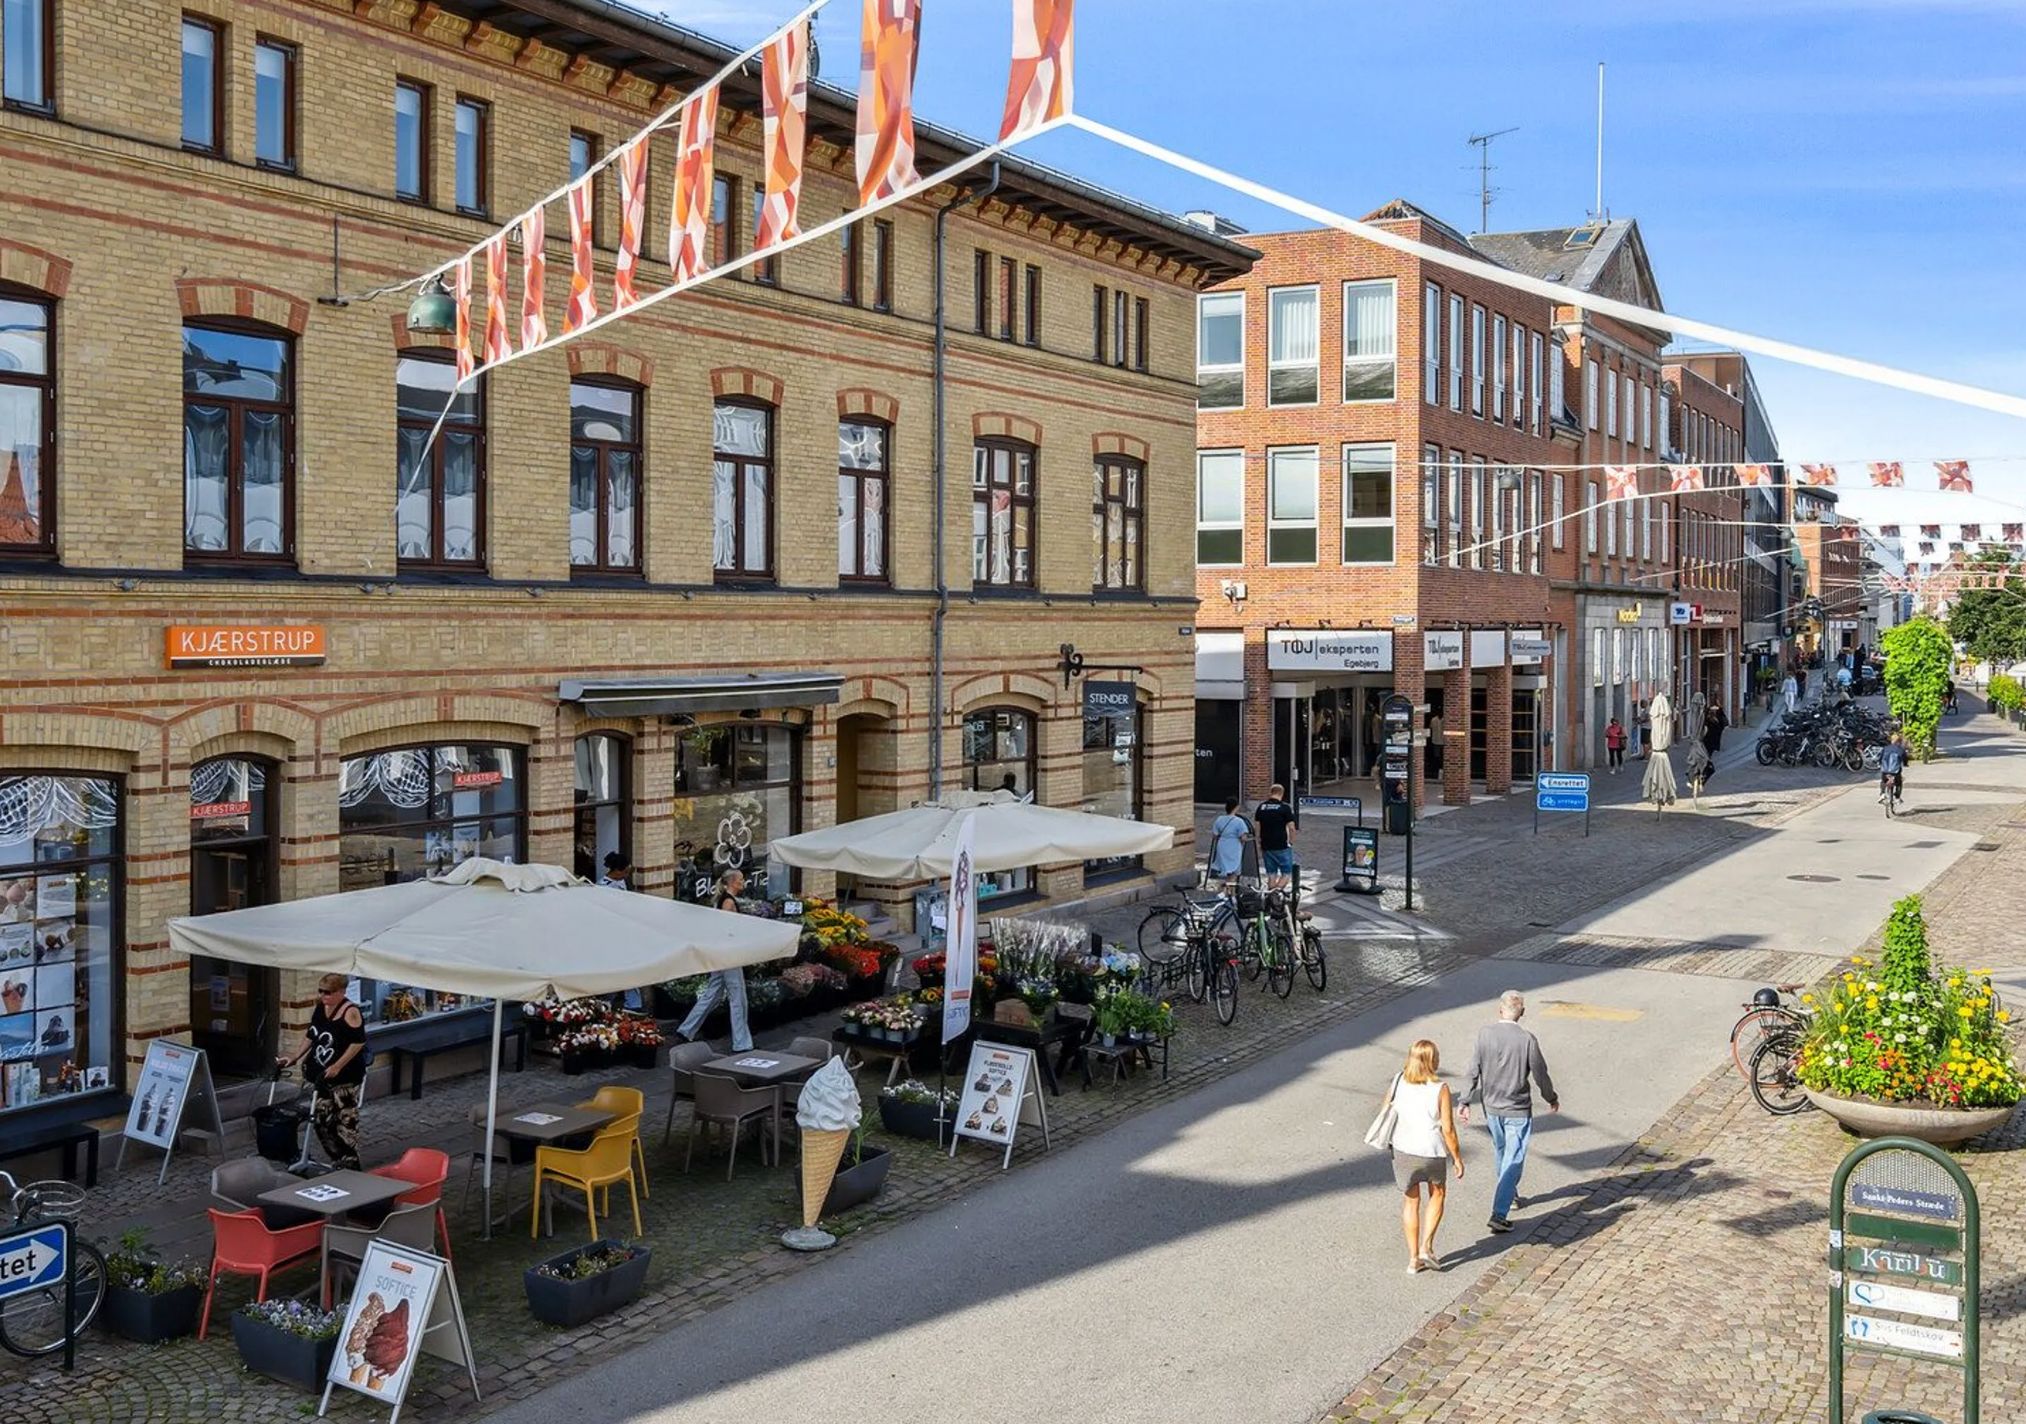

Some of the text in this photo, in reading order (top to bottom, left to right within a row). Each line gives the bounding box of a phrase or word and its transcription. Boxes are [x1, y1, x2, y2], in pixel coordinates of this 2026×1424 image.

[182, 631, 315, 652] KJÆRSTRUP
[1319, 644, 1379, 656] eksperten
[1344, 659, 1379, 669] Egebjerg
[1089, 693, 1129, 704] STENDER
[193, 803, 248, 815] KJÆRSTRUP
[0, 1250, 36, 1279] tet
[376, 1276, 418, 1299] SOFTICE
